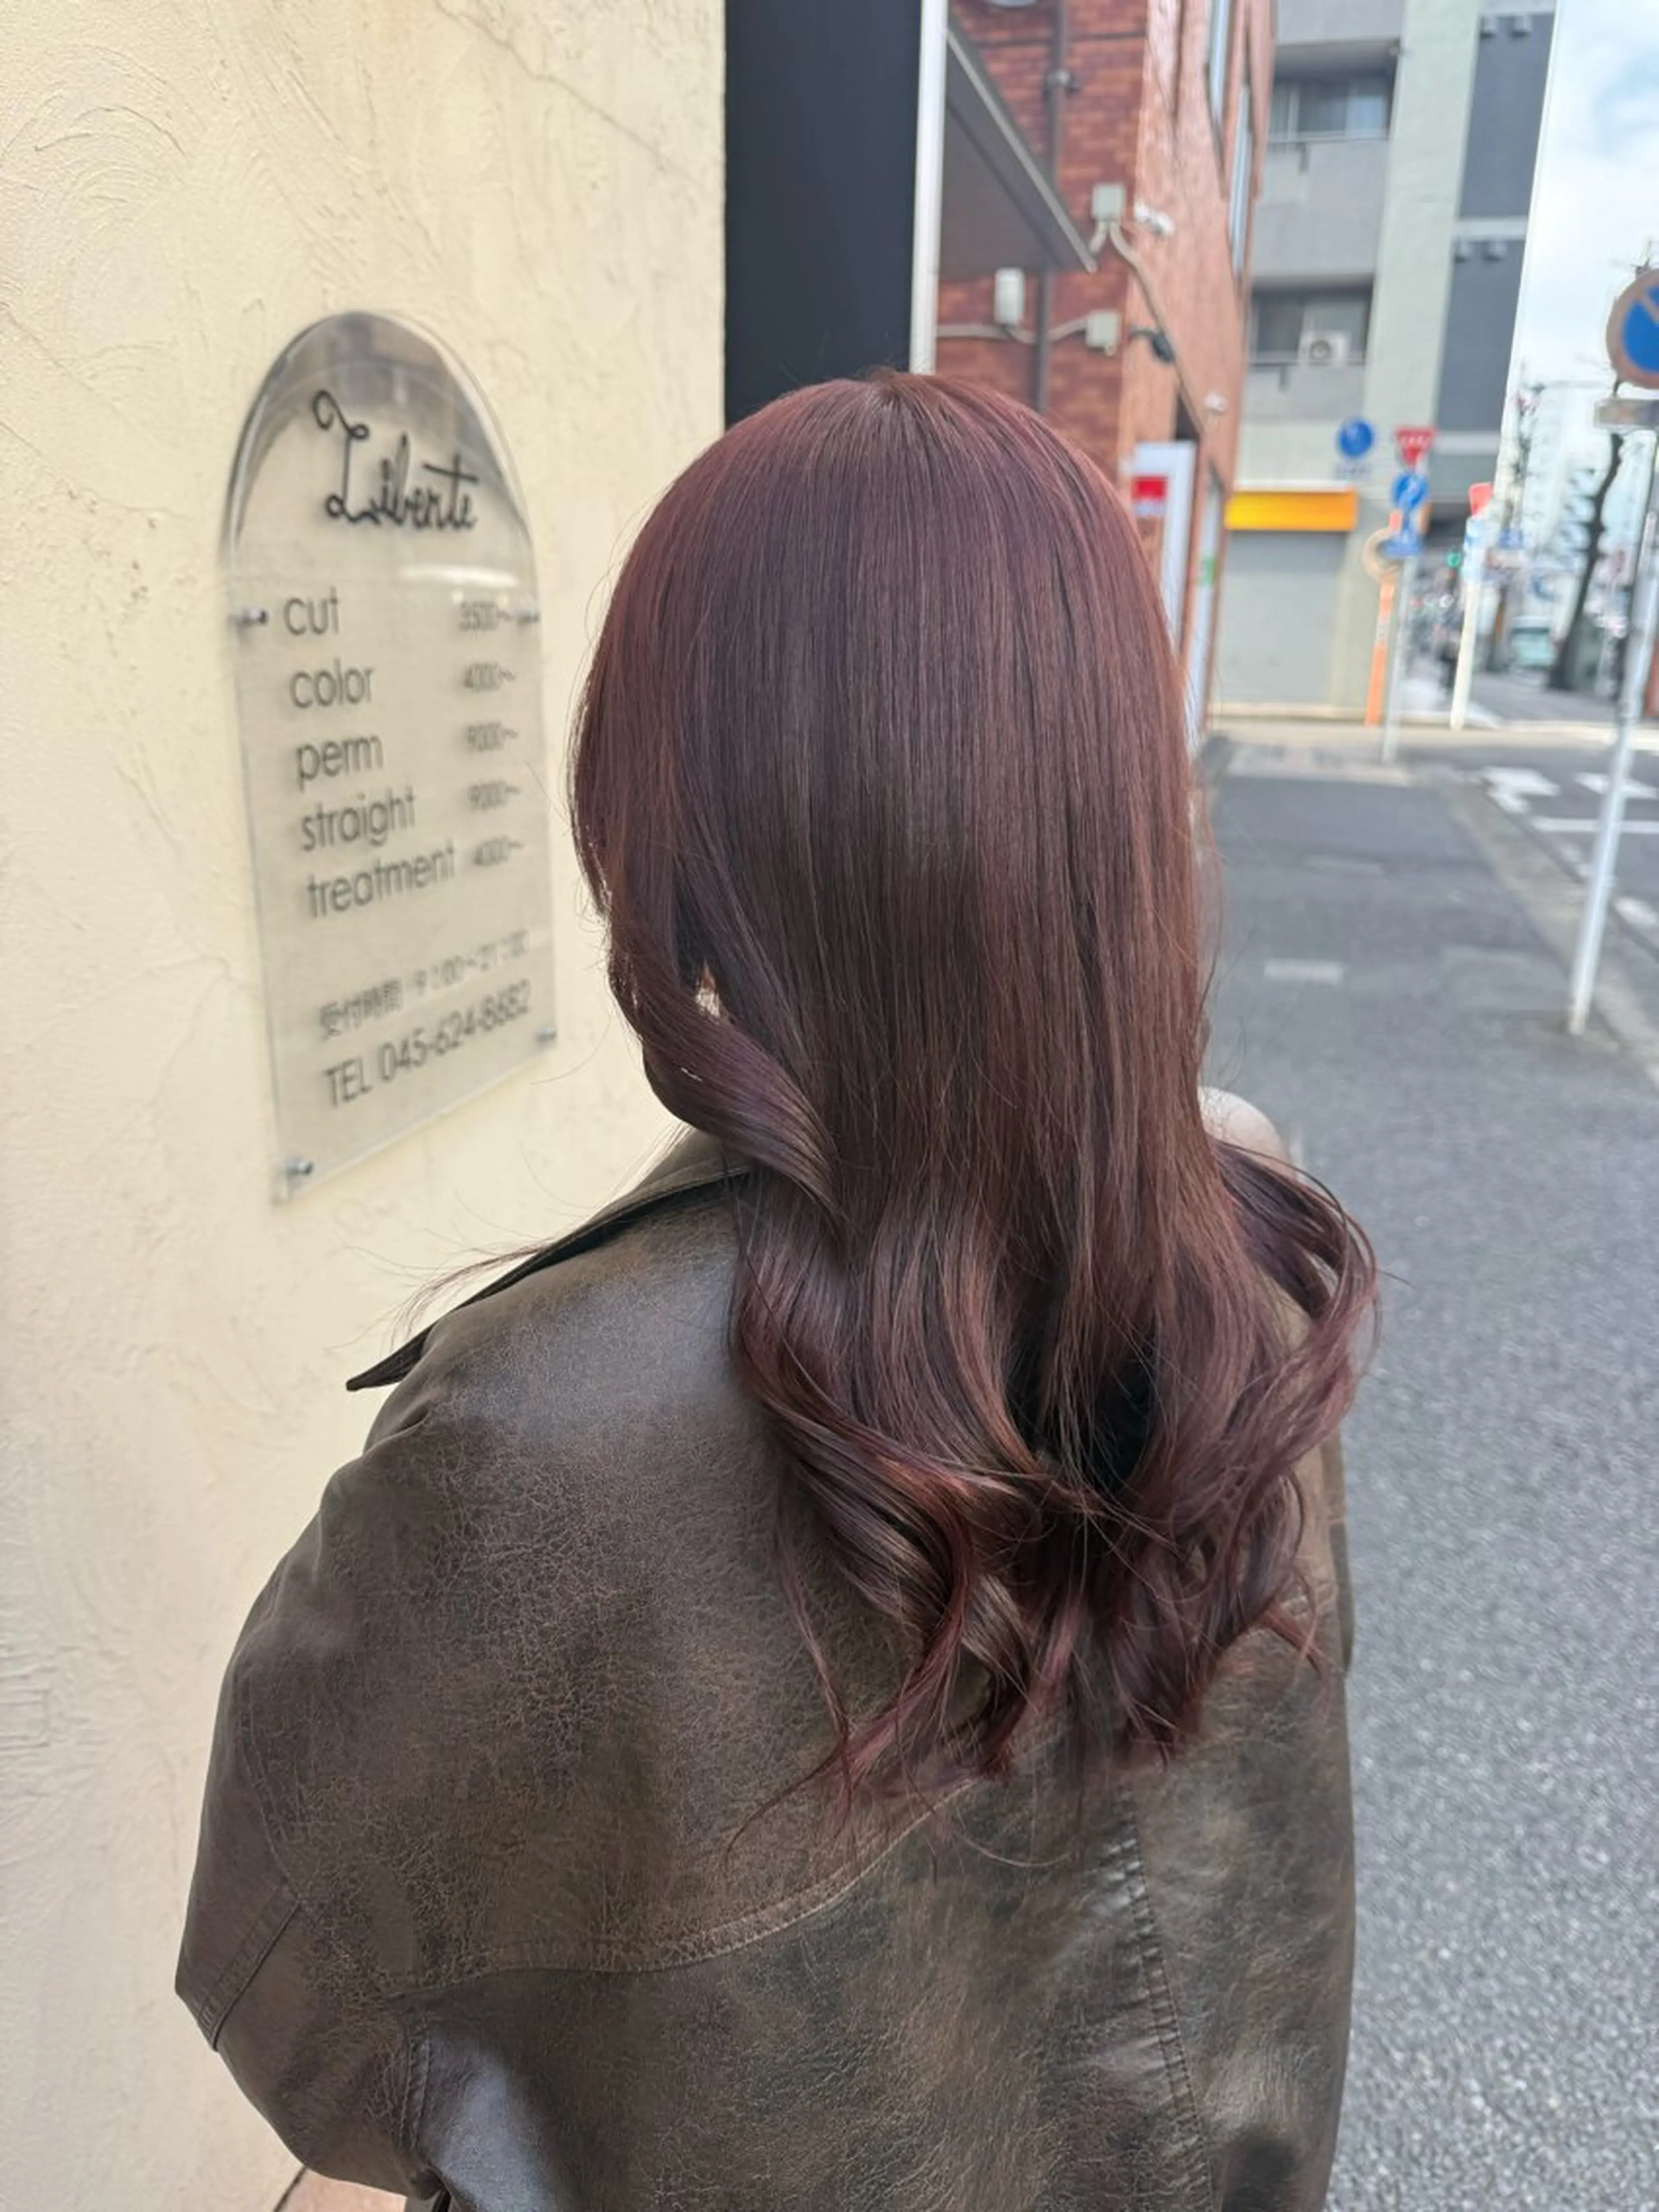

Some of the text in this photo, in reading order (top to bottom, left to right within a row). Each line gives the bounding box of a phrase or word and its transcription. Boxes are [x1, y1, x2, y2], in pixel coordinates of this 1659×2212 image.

[283, 586, 340, 636] cut
[289, 658, 373, 709] color
[296, 735, 384, 793] perm
[302, 785, 415, 852] straight
[307, 838, 454, 918] treatment
[323, 1057, 372, 1107] TEL
